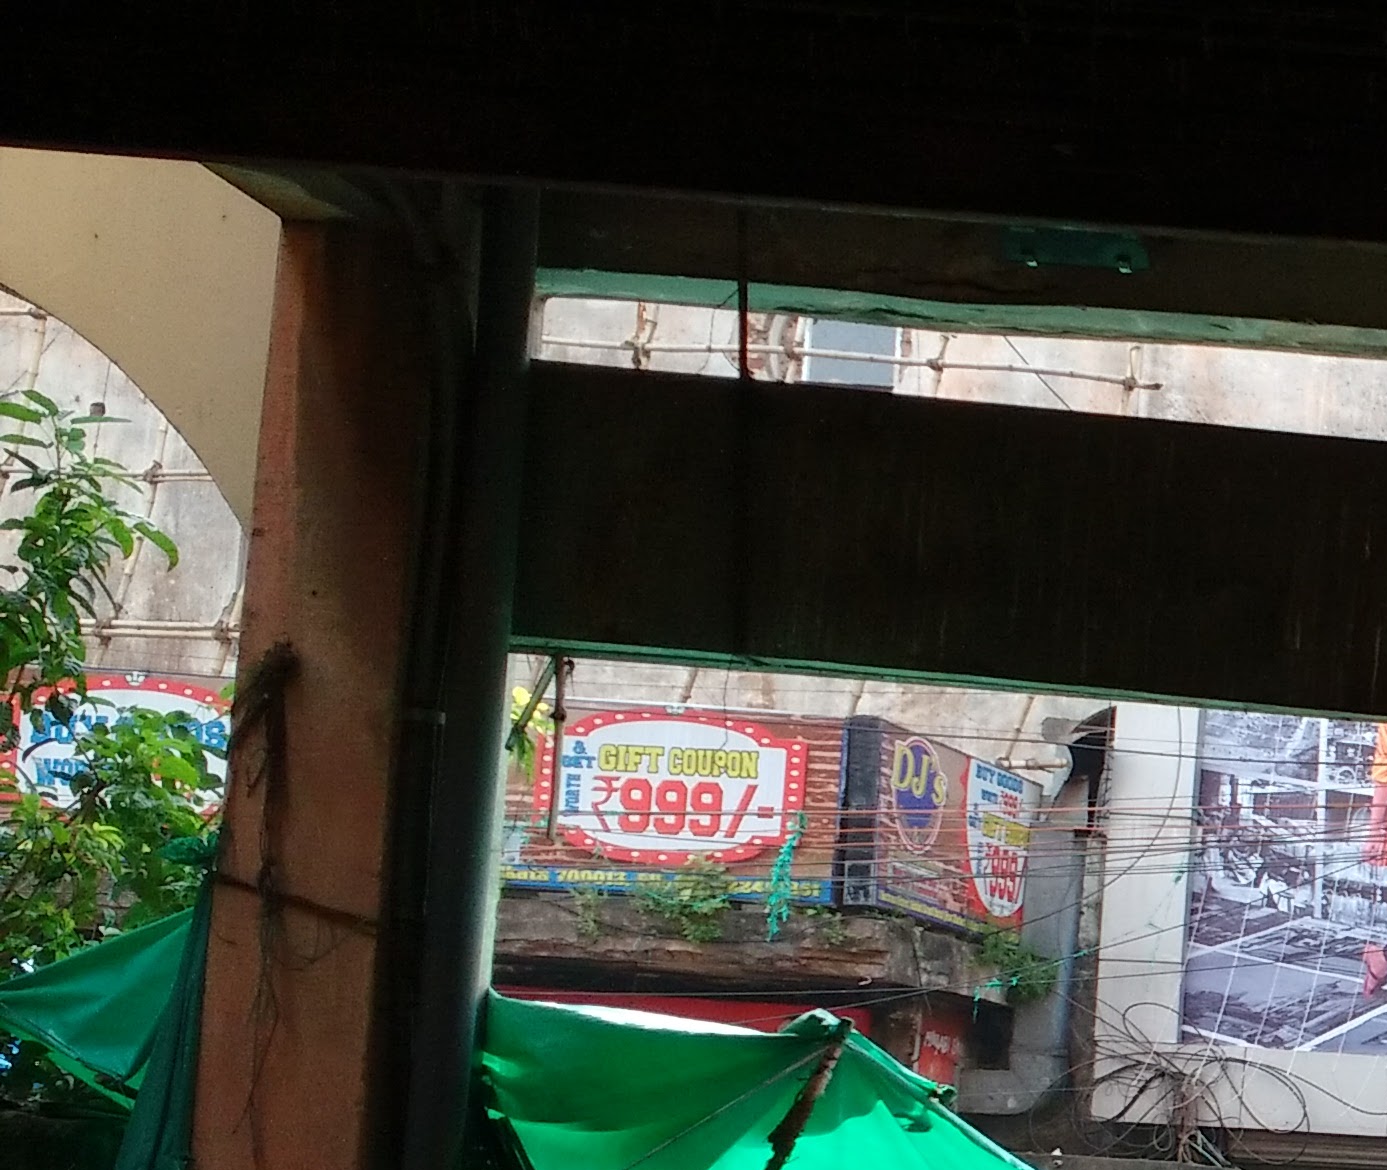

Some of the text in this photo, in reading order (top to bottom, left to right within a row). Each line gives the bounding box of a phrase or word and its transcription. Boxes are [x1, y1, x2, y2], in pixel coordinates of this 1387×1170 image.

[574, 740, 587, 755] &
[599, 744, 761, 780] GIFT COUPON
[592, 775, 775, 839] ₹999/-
